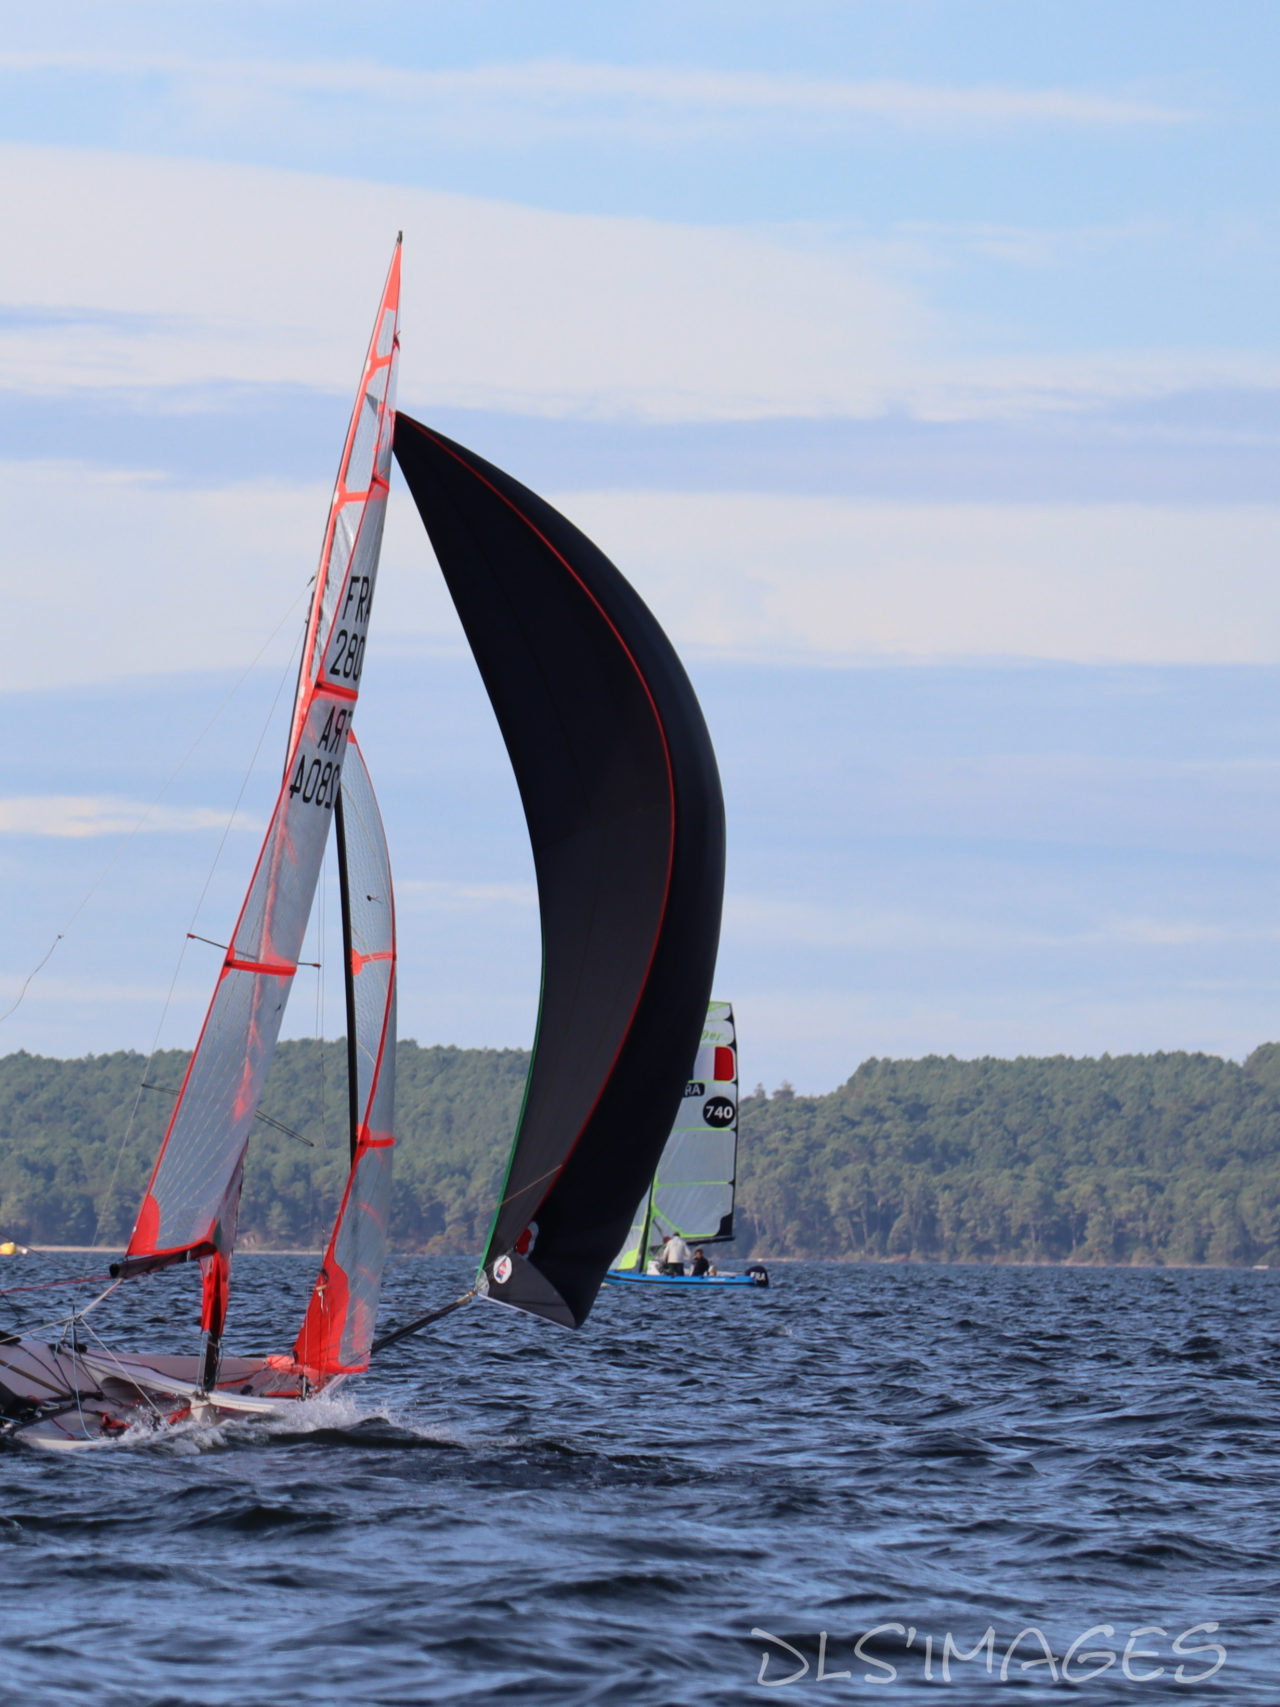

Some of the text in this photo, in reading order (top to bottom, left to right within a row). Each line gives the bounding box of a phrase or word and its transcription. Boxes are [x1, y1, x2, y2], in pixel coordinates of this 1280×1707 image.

[330, 629, 366, 681] 280
[684, 1083, 701, 1096] RA
[706, 1105, 733, 1119] 740
